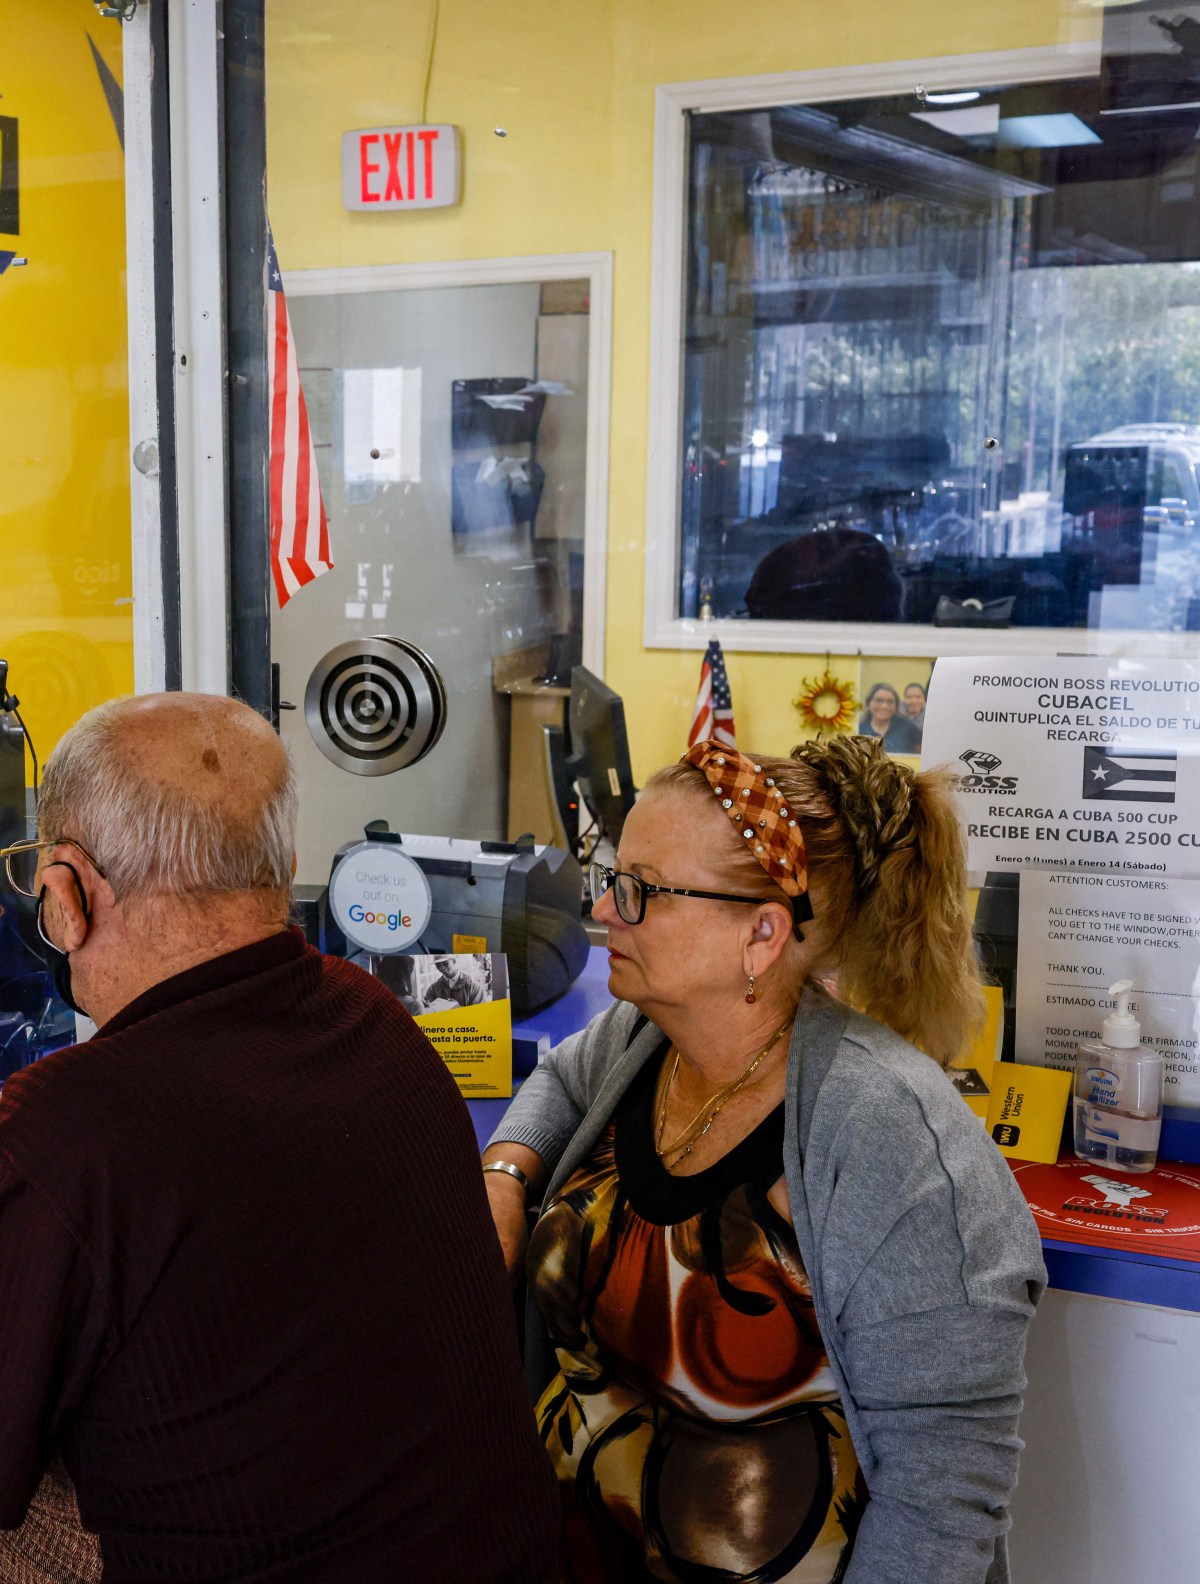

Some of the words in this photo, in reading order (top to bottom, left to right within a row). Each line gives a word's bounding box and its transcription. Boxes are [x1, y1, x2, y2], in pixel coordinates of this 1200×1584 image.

[360, 130, 439, 203] EXIT
[972, 675, 1059, 689] PROMOCION
[1063, 678, 1105, 690] BOSS
[1037, 693, 1134, 710] CUBACEL
[974, 710, 1071, 726] QUINTUPLICA
[1075, 714, 1094, 726] EL
[1099, 715, 1151, 728] SALDO
[1156, 717, 1177, 729] DE
[1047, 729, 1121, 743] RECARGA
[988, 806, 1054, 819] RECARGA
[1058, 809, 1068, 820] A
[1072, 810, 1112, 822] CUBA
[1117, 812, 1143, 823] 500
[1147, 813, 1178, 824] CUP
[967, 823, 1029, 839] RECIBE
[1035, 827, 1060, 841] EN
[1066, 828, 1119, 844] CUBA
[1125, 831, 1171, 846] 2500
[995, 855, 1022, 863] Enero
[1078, 859, 1106, 867] Enero
[1108, 860, 1120, 868] 14
[1122, 861, 1166, 872] (Sábado)
[355, 871, 390, 886] Check
[393, 876, 407, 887] us
[1049, 875, 1103, 886] ATTENTION
[1105, 877, 1169, 891] CUSTOMERS:
[363, 891, 382, 902] out
[384, 893, 399, 902] on
[348, 904, 412, 931] Google
[1048, 907, 1063, 915] ALL
[1065, 908, 1100, 917] CHECKS
[1101, 910, 1126, 919] HAVE
[1128, 912, 1141, 920] TO
[1143, 913, 1154, 921] BE
[1157, 914, 1191, 924] SIGNED
[1048, 919, 1067, 928] YOU
[1069, 920, 1086, 929] GET
[1088, 921, 1101, 930] TO
[1103, 922, 1120, 932] THE
[1075, 933, 1113, 944] CHANGE
[1116, 936, 1141, 945] YOUR
[1143, 938, 1181, 949] CHECKS.
[1047, 963, 1079, 973] THANK
[1081, 965, 1105, 976] YOU.
[1046, 995, 1096, 1007] ESTIMADO
[453, 1035, 461, 1043] la
[463, 1035, 496, 1044] puerta.
[1092, 1086, 1116, 1098] Hand
[1000, 1086, 1015, 1120] Western
[1011, 1093, 1024, 1117] Union
[999, 1126, 1012, 1144] WU
[1040, 1208, 1057, 1217] PIN
[1061, 1204, 1166, 1225] REVOLUTION
[1064, 1196, 1169, 1218] BOSS
[1064, 1217, 1084, 1225] SIN
[1086, 1222, 1132, 1233] CARGOS
